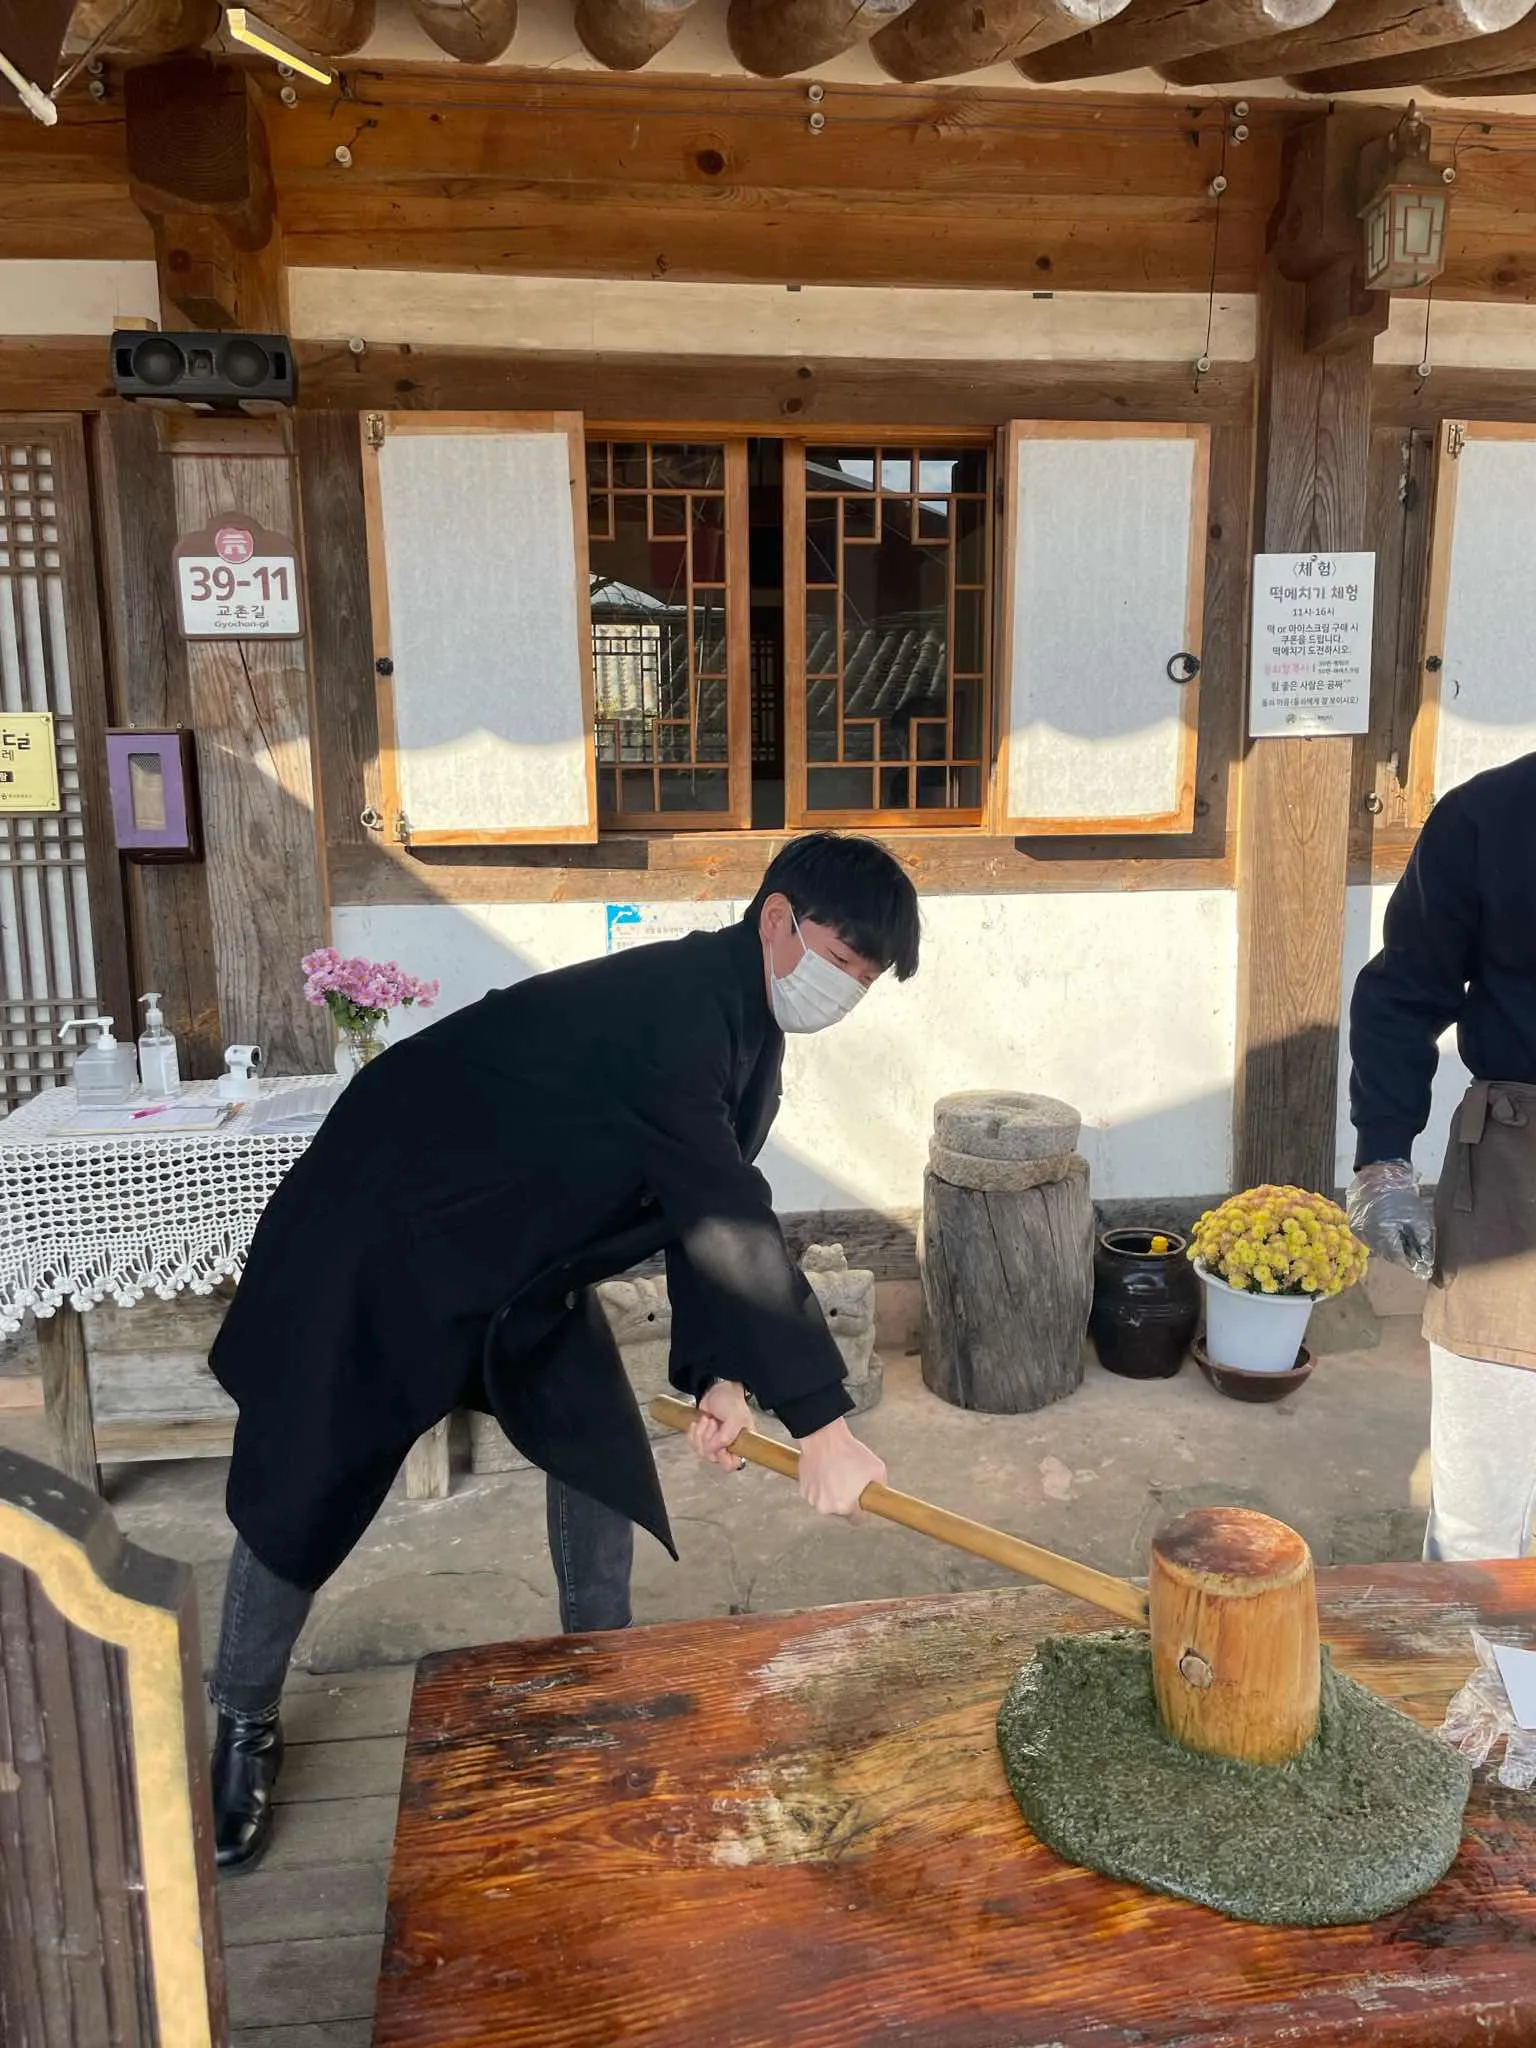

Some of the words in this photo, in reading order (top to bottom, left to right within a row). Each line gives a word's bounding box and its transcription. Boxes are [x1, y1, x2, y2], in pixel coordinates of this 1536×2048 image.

[190, 566, 288, 601] 39-11
[1331, 584, 1358, 601] 체험
[216, 605, 265, 619] 교촌길
[1288, 623, 1330, 633] 아이스크림
